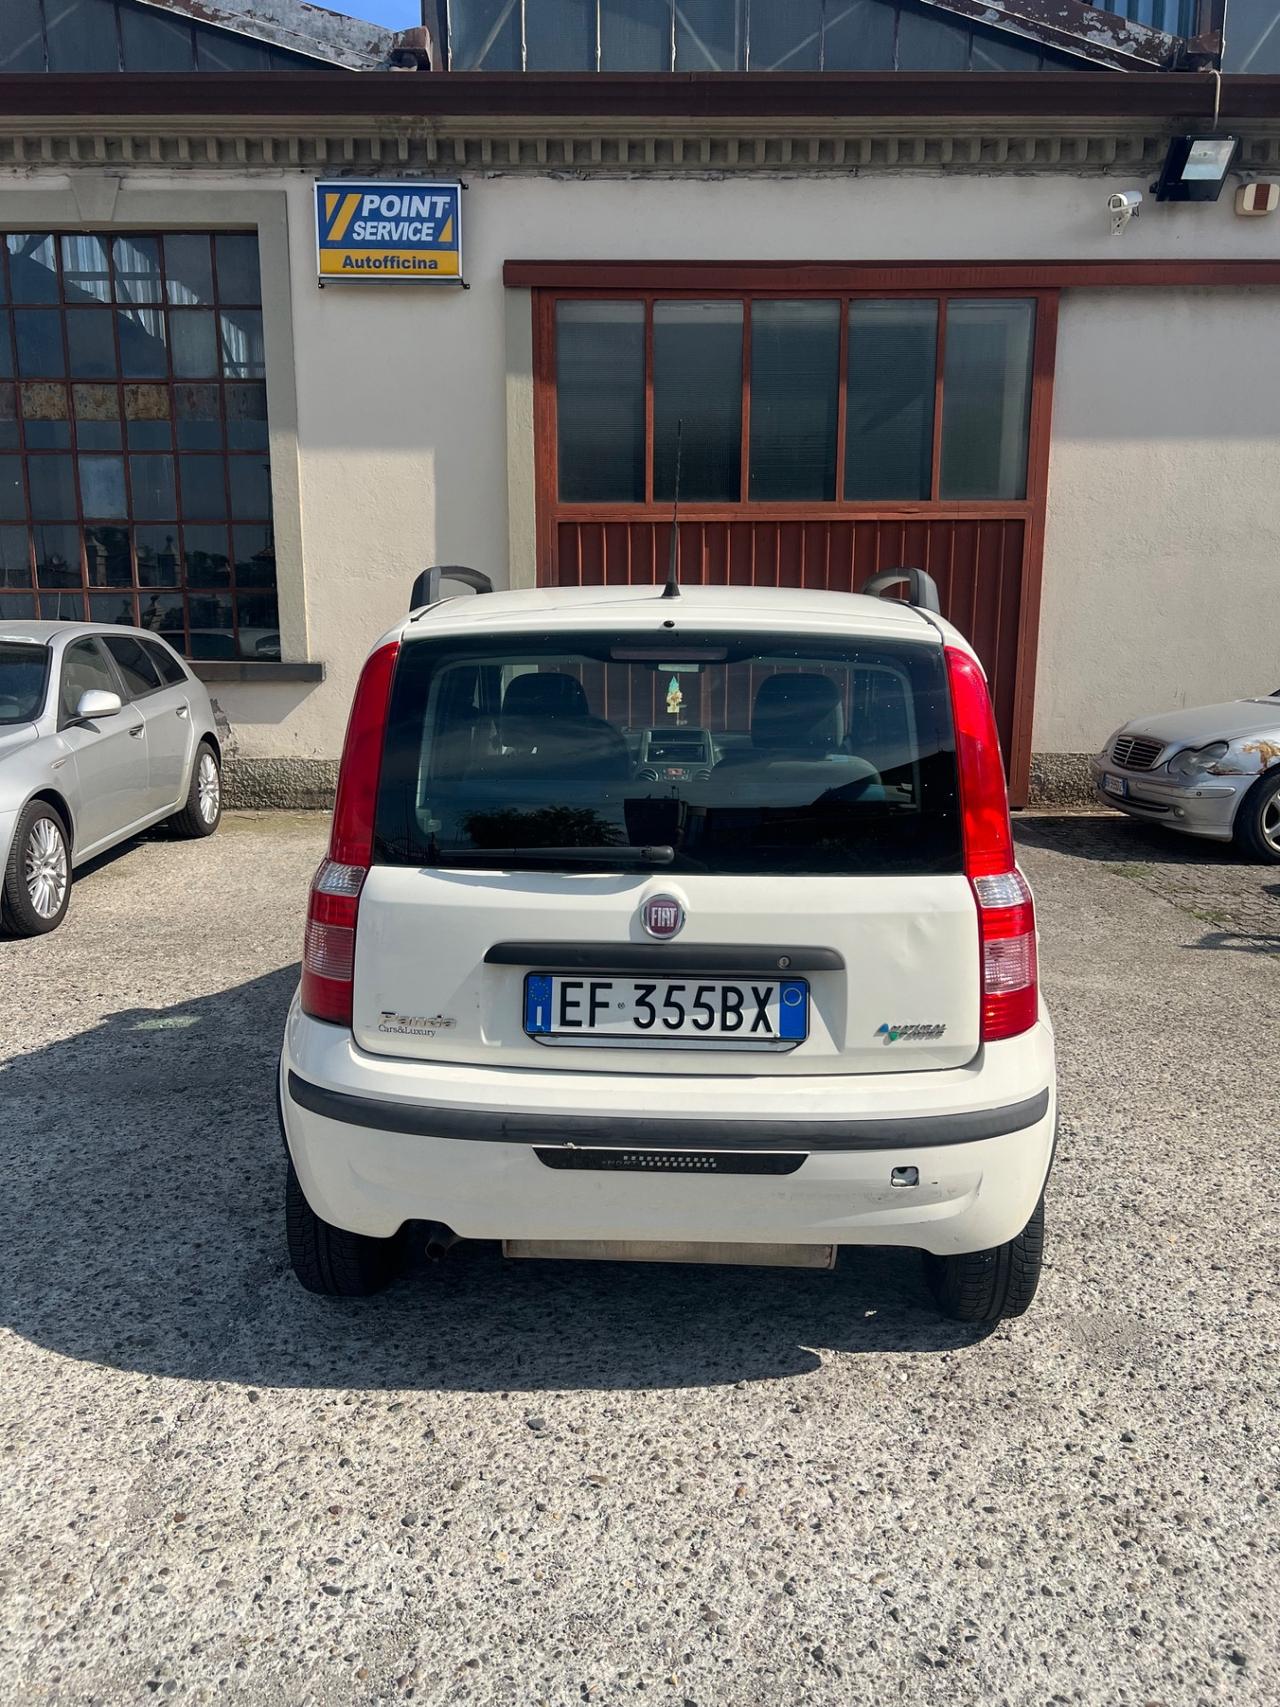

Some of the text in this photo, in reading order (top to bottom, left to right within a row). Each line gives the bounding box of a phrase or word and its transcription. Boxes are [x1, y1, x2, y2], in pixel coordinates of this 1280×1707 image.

[361, 194, 451, 218] POINT
[352, 220, 435, 241] SERVICE
[342, 255, 438, 270] Autofficina
[651, 907, 678, 927] FIAT
[559, 981, 613, 1028] EF
[633, 984, 774, 1033] 355BX
[378, 1023, 437, 1038] Cars&Luxury
